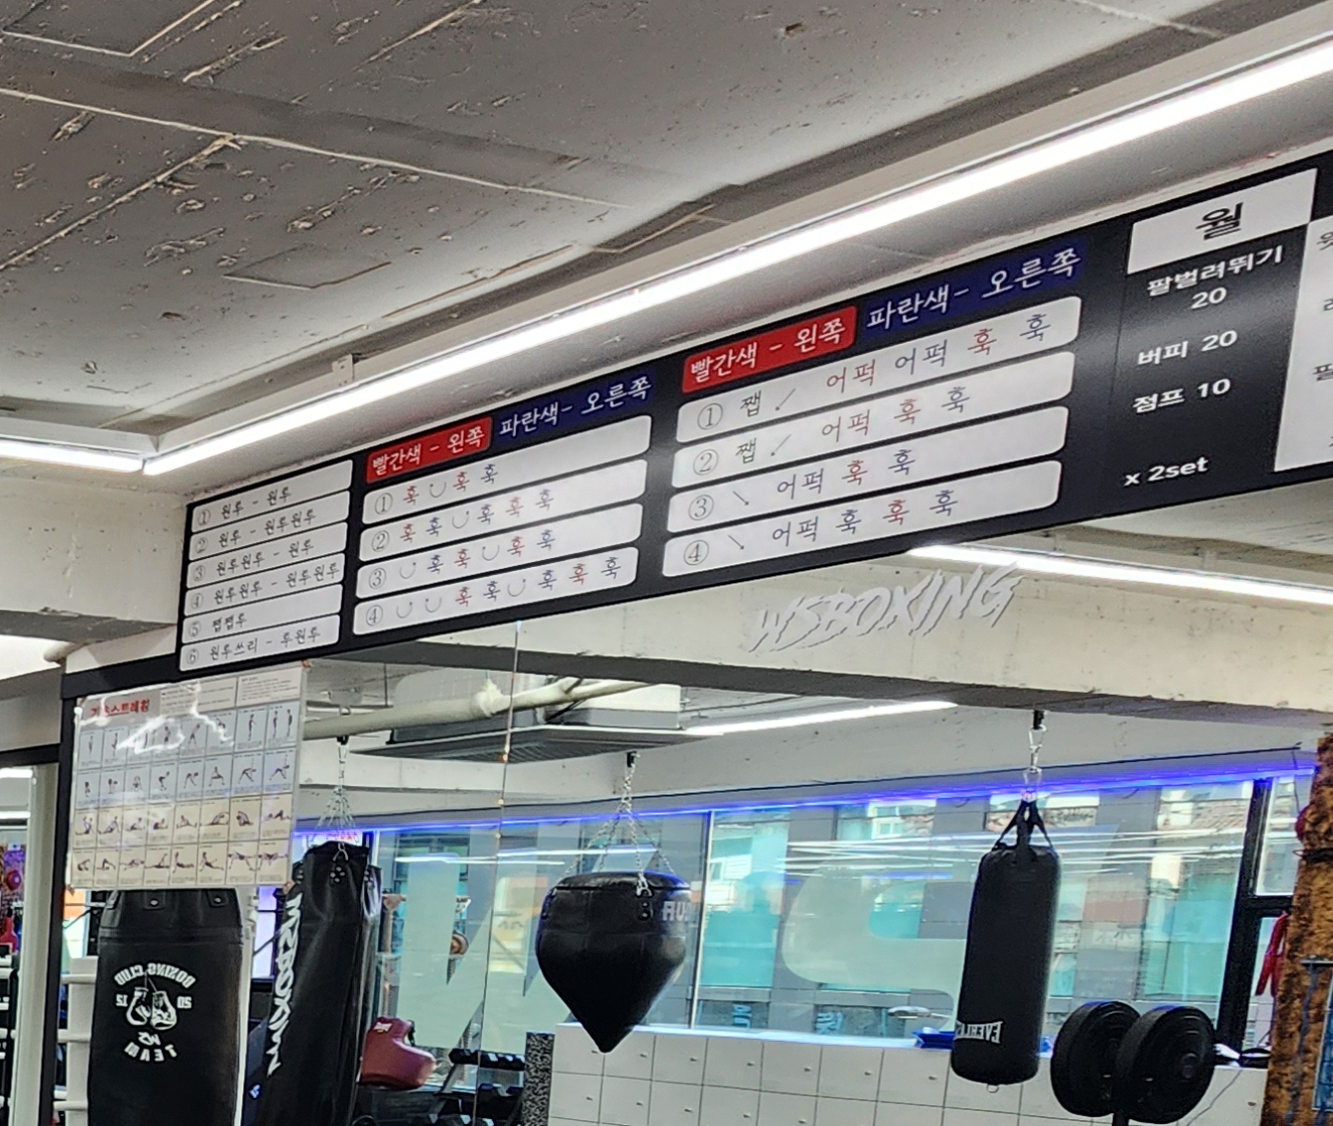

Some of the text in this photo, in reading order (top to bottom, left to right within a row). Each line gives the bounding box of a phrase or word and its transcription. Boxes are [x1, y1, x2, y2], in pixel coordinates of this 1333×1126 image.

[1195, 202, 1244, 241] 월
[980, 247, 1082, 300] 오른쪽
[1147, 245, 1283, 297] 팔벌려뛰기
[1190, 287, 1227, 310] 20
[690, 342, 758, 383] 빨간색
[794, 320, 847, 354] 왼쪽
[967, 327, 998, 356] 훅
[1019, 313, 1052, 341] 훅
[1137, 330, 1238, 367] 버피 20
[580, 376, 652, 414] 오른쪽
[893, 397, 923, 425] 훅
[940, 385, 971, 414] 훅
[1133, 378, 1231, 414] 점프 10
[372, 443, 421, 476] 빨간색
[447, 425, 486, 453] 왼쪽
[841, 459, 868, 487] 훅
[887, 448, 917, 477] 훅
[1148, 456, 1209, 483] 2set
[403, 484, 420, 506] 훅
[453, 471, 470, 491] 훅
[480, 463, 498, 484] 훅
[399, 523, 416, 543] 훅
[426, 516, 443, 537] 훅
[477, 503, 494, 524] 훅
[506, 496, 523, 517] 훅
[535, 488, 554, 510] 훅
[834, 508, 862, 535] 훅
[882, 499, 910, 525] 훅
[929, 488, 958, 517] 훅
[427, 554, 444, 574] 훅
[454, 548, 471, 569] 훅
[507, 535, 525, 557] 훅
[536, 528, 555, 550] 훅
[455, 586, 472, 607] 훅
[483, 580, 500, 601] 훅
[537, 569, 557, 590] 훅
[569, 563, 587, 585] 훅
[601, 556, 621, 579] 훅
[749, 561, 1025, 654] WSBOXING
